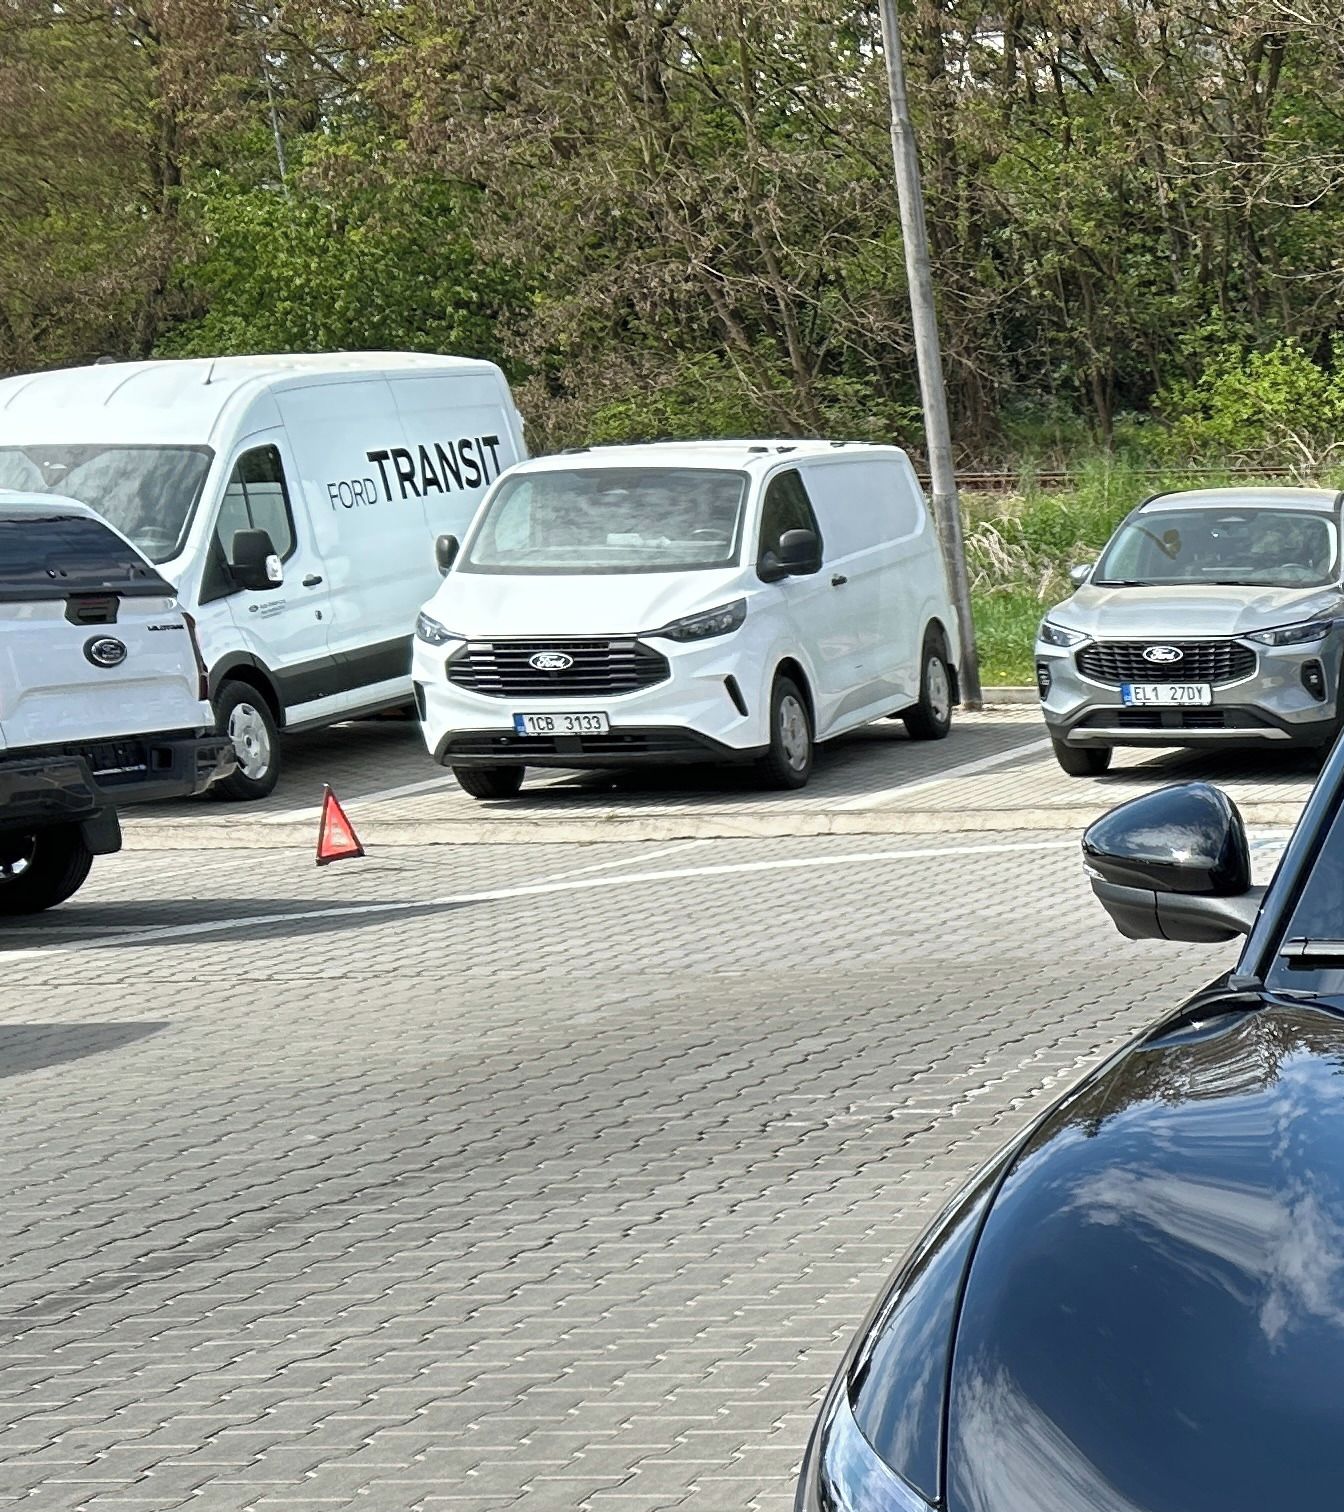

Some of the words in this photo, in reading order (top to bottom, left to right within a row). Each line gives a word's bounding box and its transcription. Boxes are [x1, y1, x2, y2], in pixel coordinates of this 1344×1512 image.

[327, 478, 378, 511] FORD
[366, 435, 500, 502] TRANSIT
[1134, 686, 1160, 701] EL1
[1169, 686, 1204, 701] 27DY
[528, 716, 555, 731] 1CB
[564, 715, 601, 731] 3133
